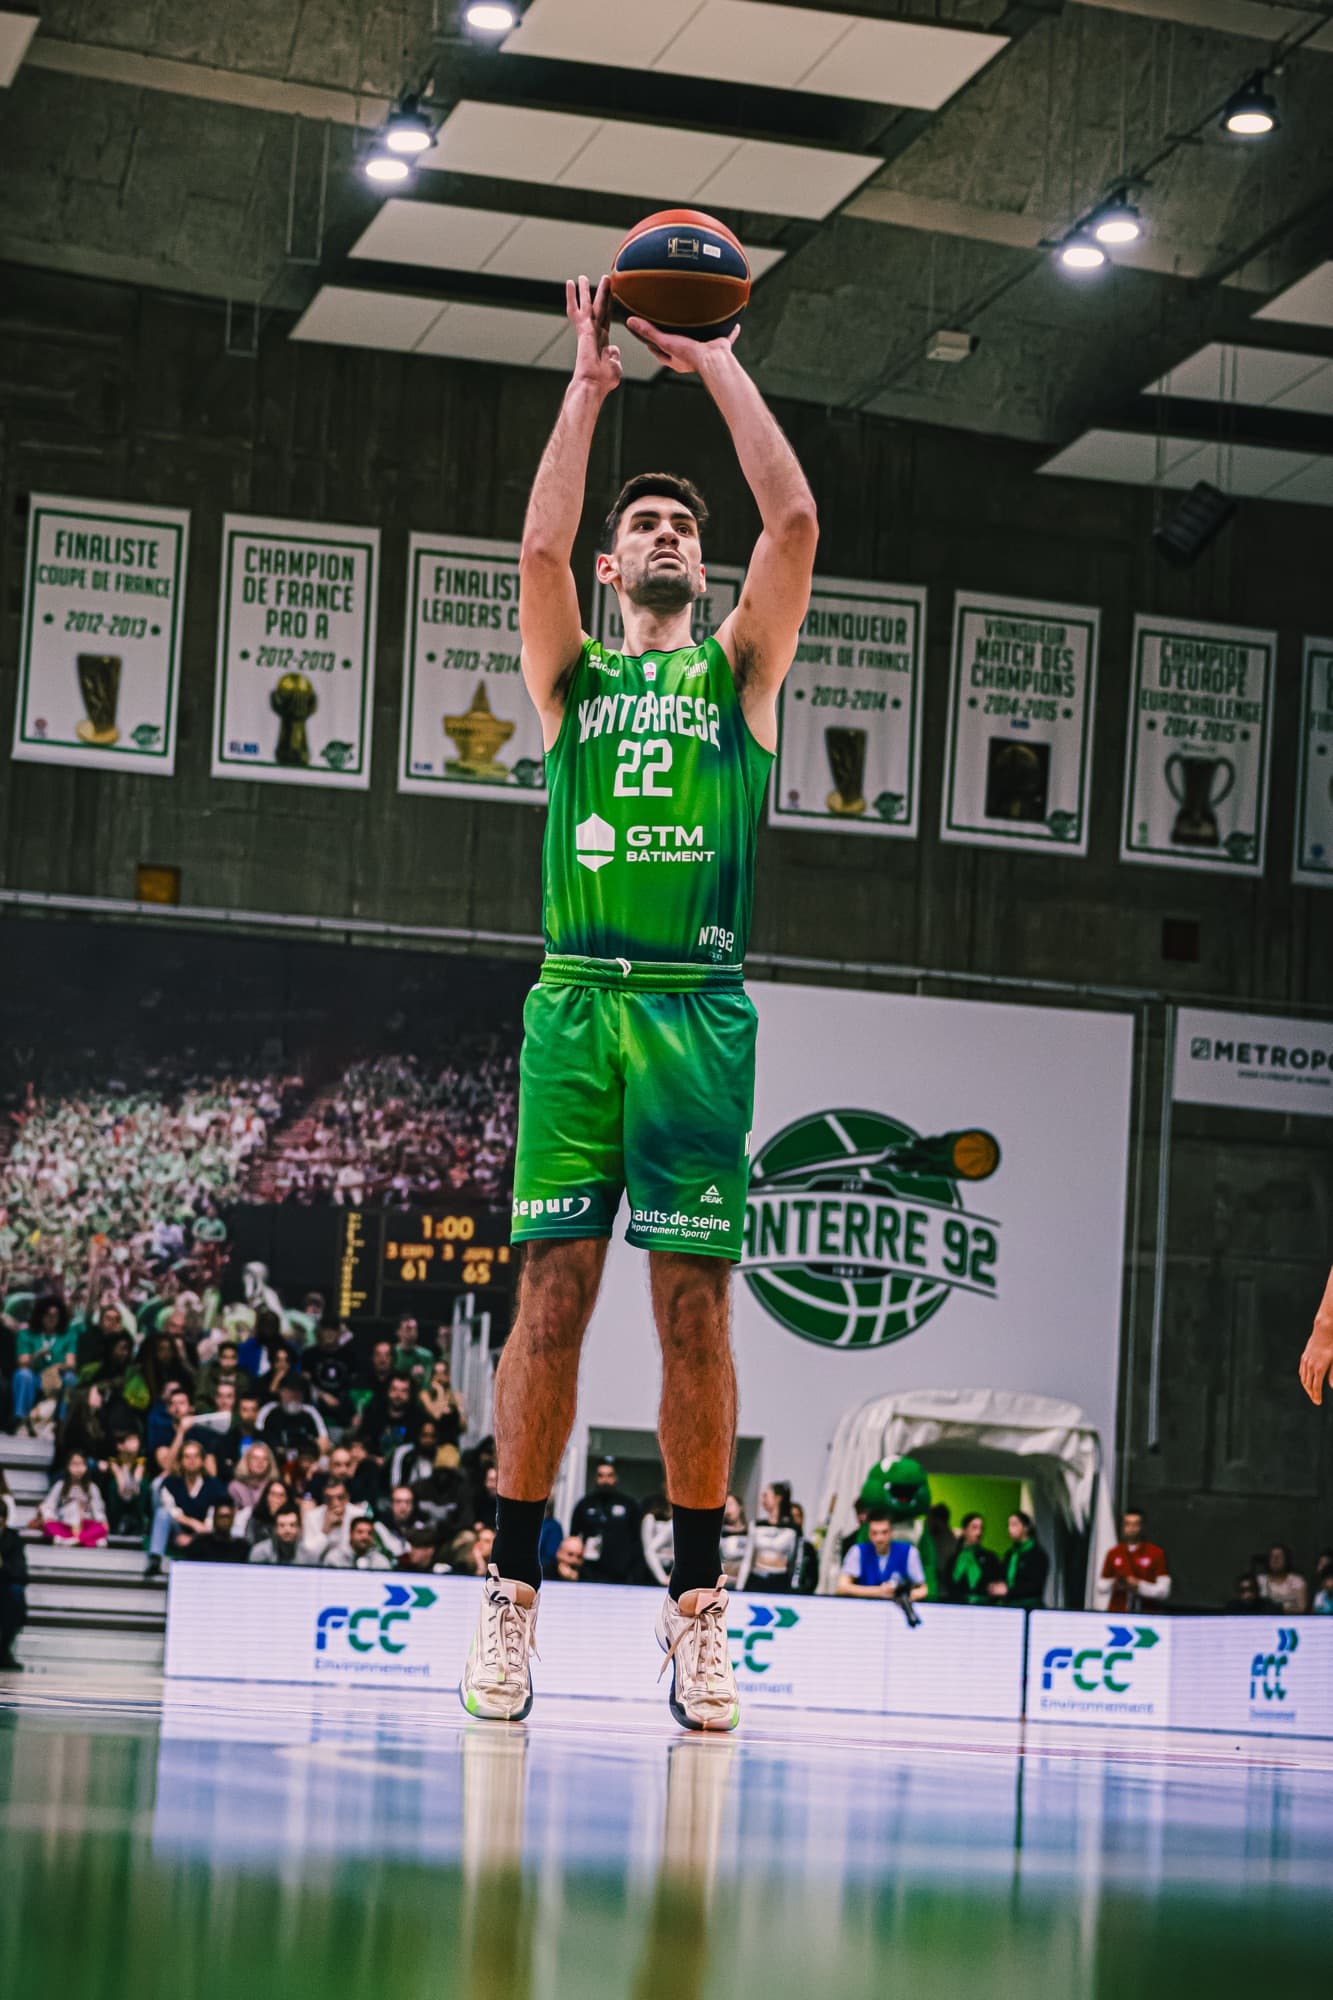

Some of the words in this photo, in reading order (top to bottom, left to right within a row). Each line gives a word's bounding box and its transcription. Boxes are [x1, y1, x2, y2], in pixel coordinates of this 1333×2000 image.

[54, 529, 160, 570] FINALISTE
[244, 545, 355, 583] CHAMPION
[37, 563, 87, 590] COUPE
[91, 569, 110, 592] DE
[114, 572, 171, 599] FRANCE
[242, 575, 268, 605] DE
[275, 579, 354, 614] FRANCE
[434, 564, 521, 602] FINALIST
[63, 610, 149, 640] 2012-2013
[265, 608, 308, 639] PRO
[314, 613, 329, 641] A
[422, 597, 502, 631] LEADERS
[798, 608, 908, 646] AINQUEUR
[255, 644, 337, 673] 2012-2013
[975, 636, 1036, 668] MATCH
[1041, 645, 1075, 673] DES
[970, 662, 1076, 699] CHAMPIONS
[613, 739, 673, 797] 22
[625, 825, 704, 847] GTM
[625, 849, 716, 862] BÂTIMENT
[700, 1194, 724, 1205] PEAK
[422, 1214, 475, 1240] 1:00
[680, 1228, 711, 1241] Sportif
[743, 1199, 928, 1268] ANTERRE
[942, 1218, 998, 1289] 92
[316, 1607, 411, 1654] FCC
[314, 1657, 430, 1677] Environnement
[1042, 1648, 1134, 1693] FCC
